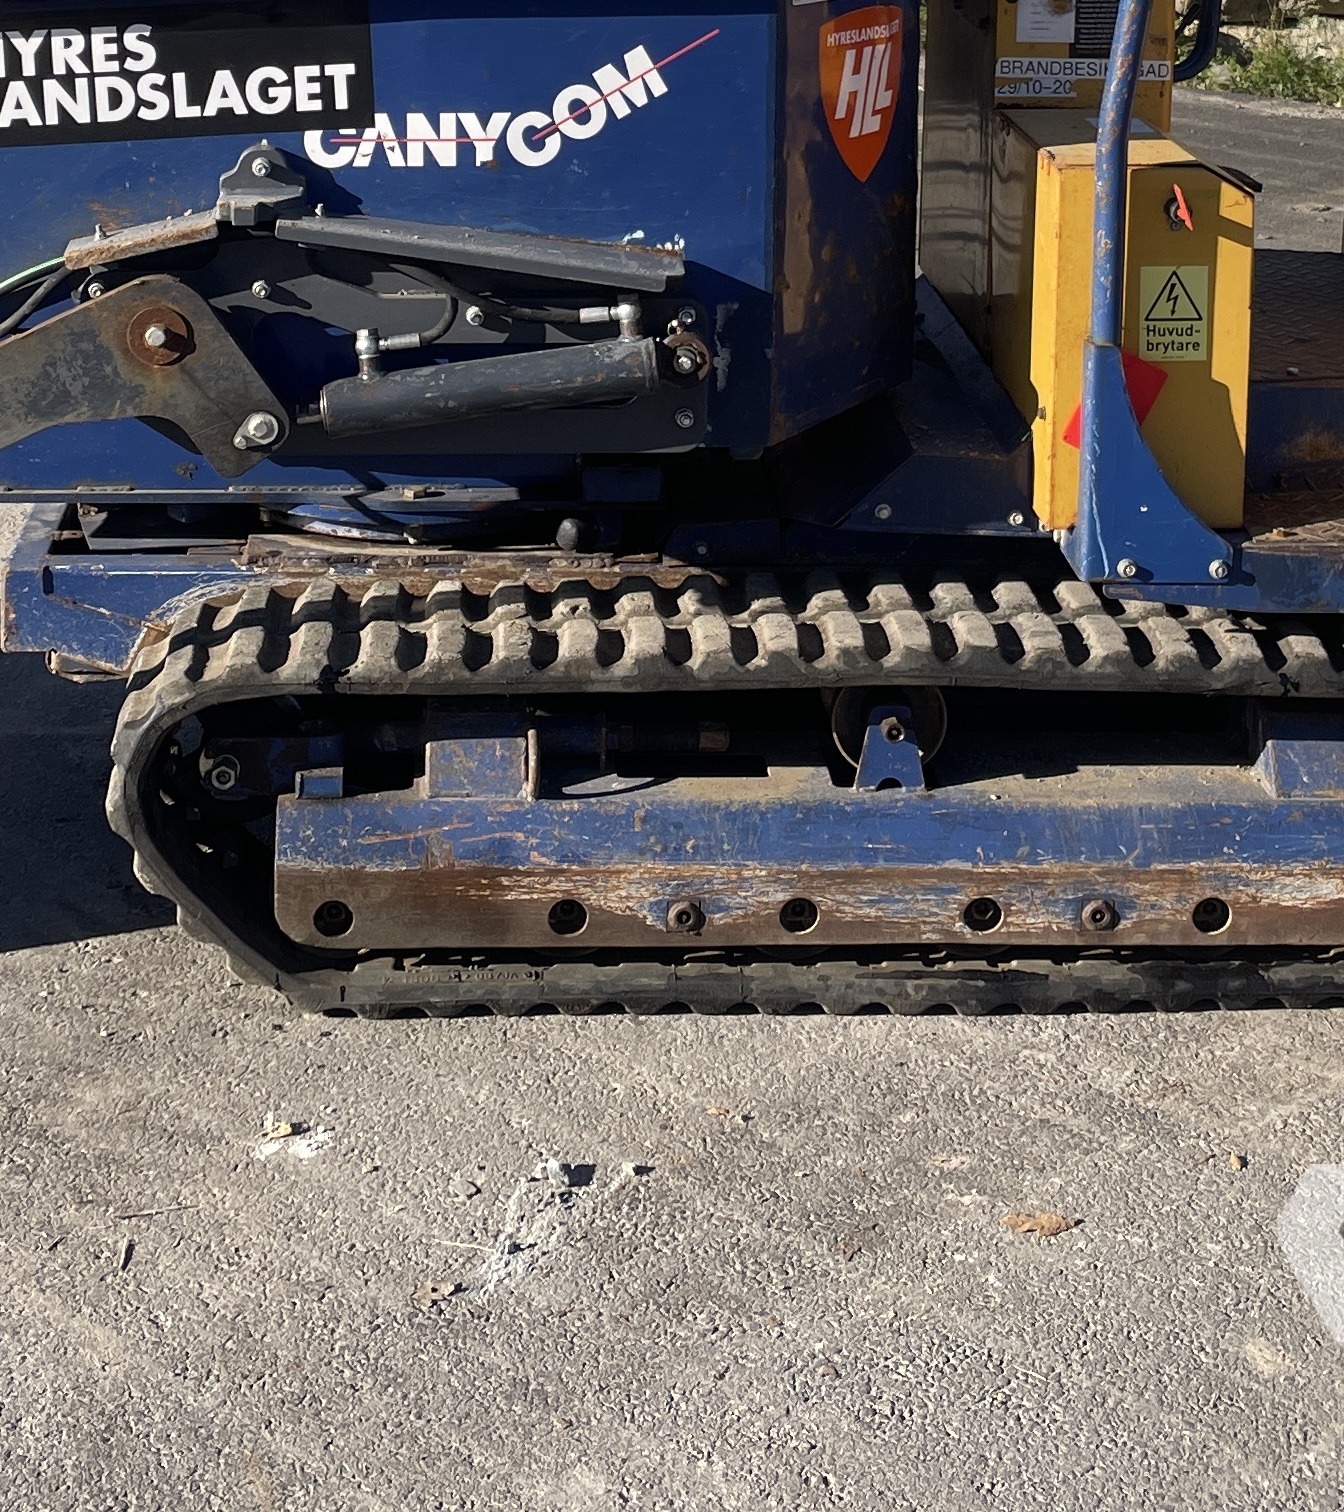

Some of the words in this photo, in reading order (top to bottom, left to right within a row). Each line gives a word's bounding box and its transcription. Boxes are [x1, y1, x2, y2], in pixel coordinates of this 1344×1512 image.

[303, 44, 669, 168] CANYCOM
[834, 40, 893, 139] HLL
[1146, 324, 1201, 338] Huvud-
[1146, 339, 1200, 355] brytare
